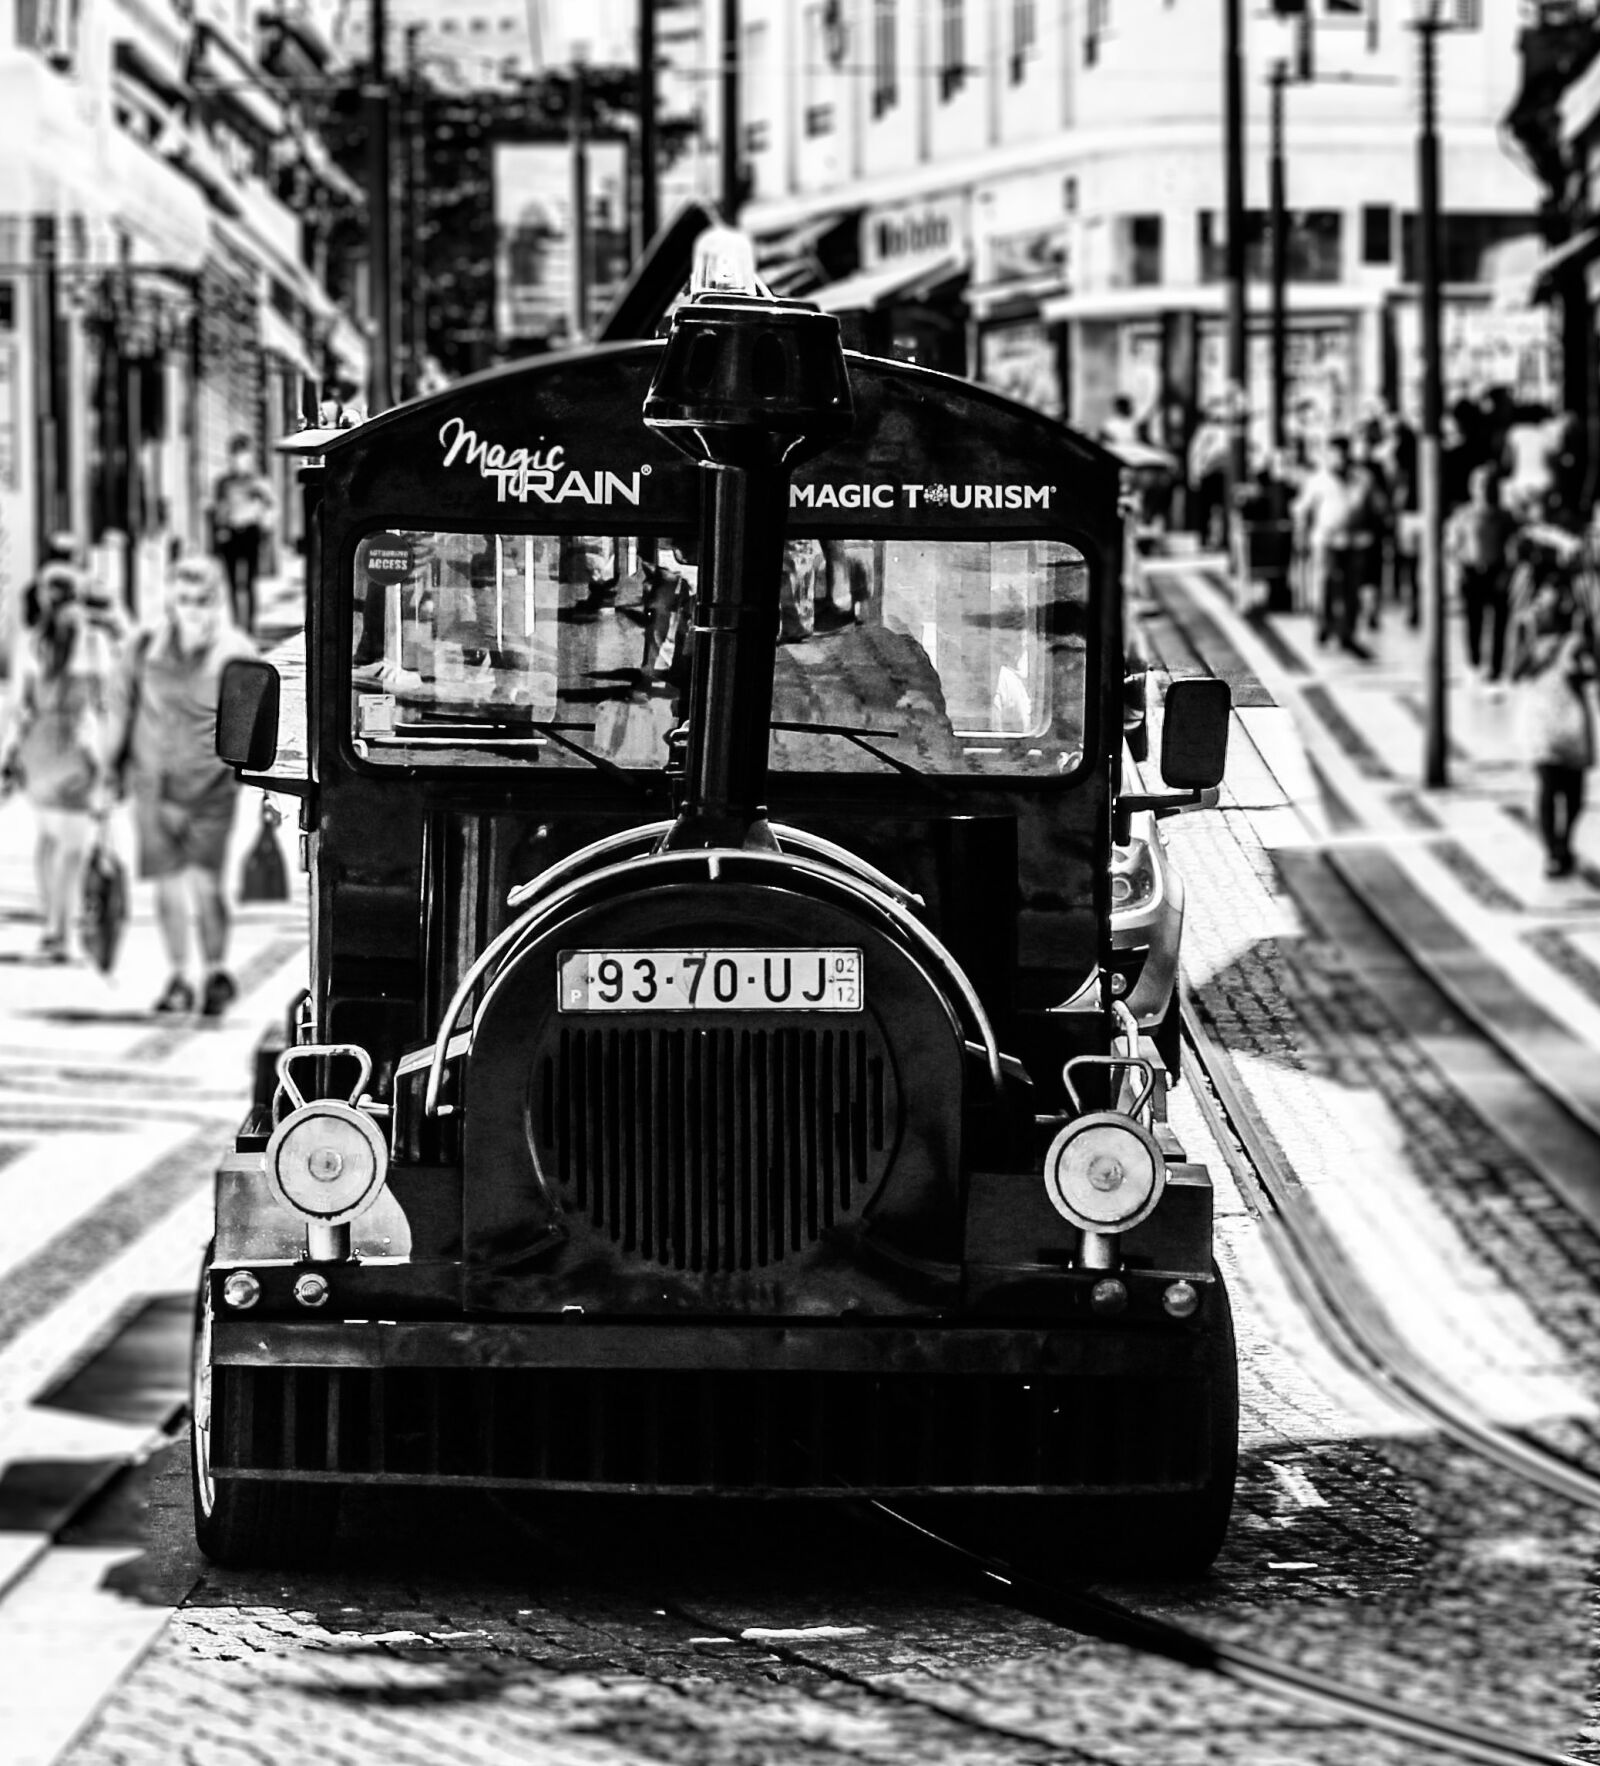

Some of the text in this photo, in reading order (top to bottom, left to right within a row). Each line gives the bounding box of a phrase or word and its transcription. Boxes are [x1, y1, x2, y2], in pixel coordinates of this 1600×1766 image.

[439, 417, 566, 496] Magic
[789, 484, 894, 508] MAGIC
[368, 558, 408, 570] ACCESS
[835, 957, 855, 973] 02
[570, 989, 582, 1003] P
[837, 986, 855, 1003] 12
